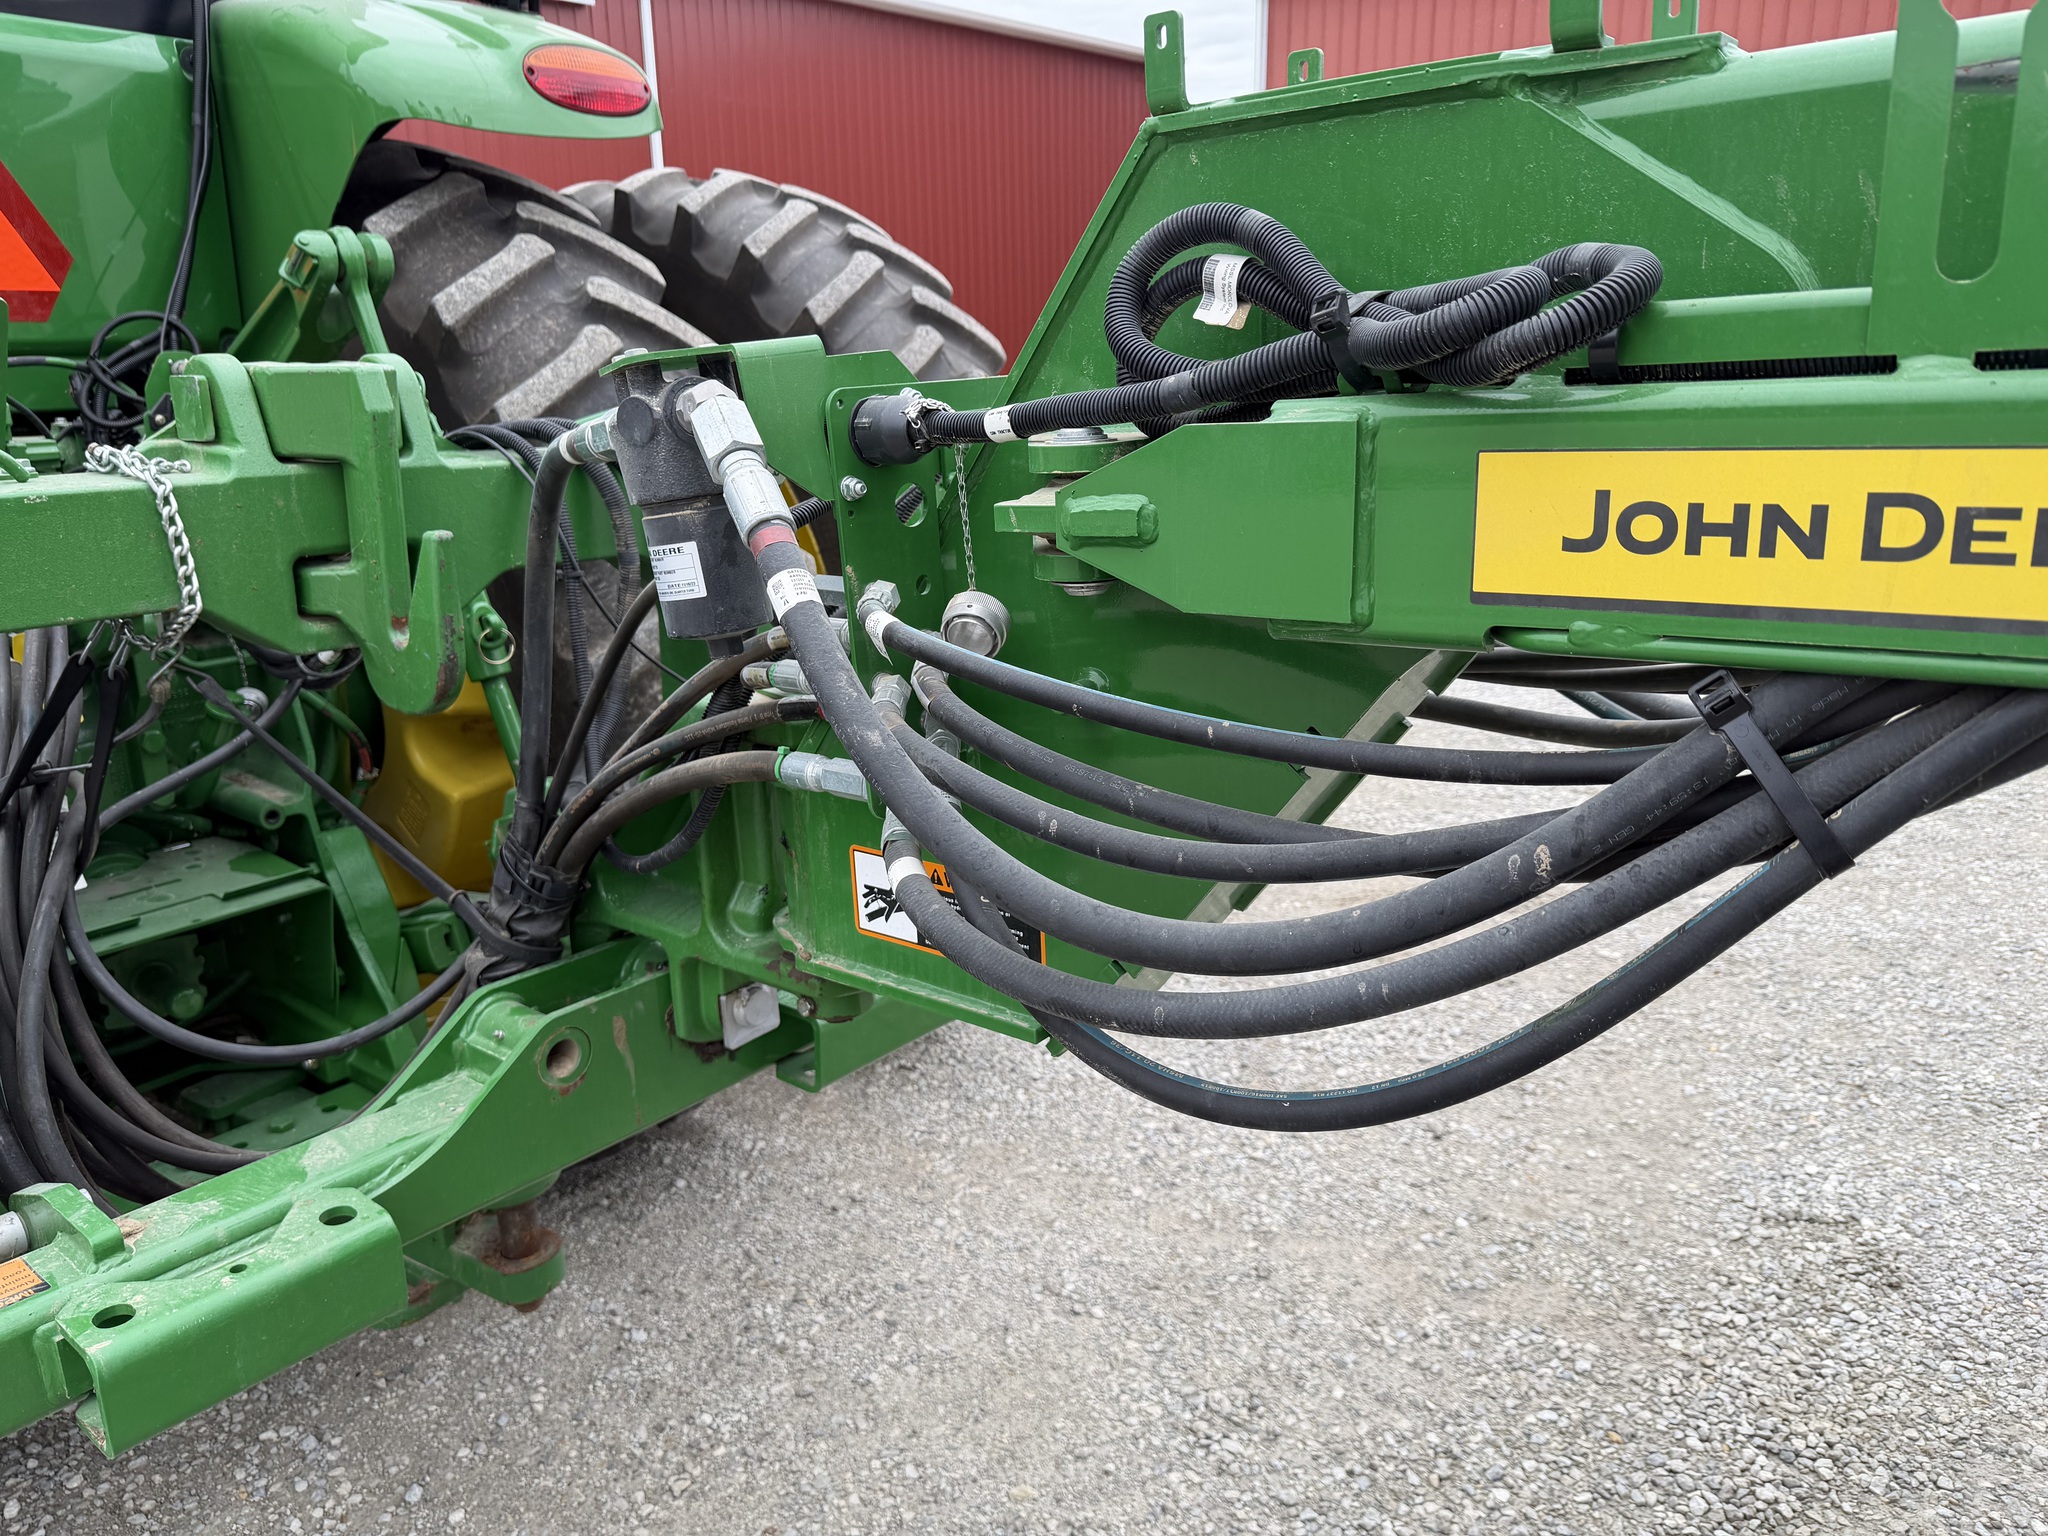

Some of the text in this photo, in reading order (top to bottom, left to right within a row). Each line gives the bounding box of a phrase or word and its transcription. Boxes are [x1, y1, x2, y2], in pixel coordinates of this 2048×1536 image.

[1223, 282, 1233, 314] MONCLOVA
[1562, 489, 2048, 568] JOHN DE
[653, 546, 684, 556] DEERE
[1644, 776, 1711, 822] 13:59:44
[1608, 824, 1636, 845] GEN
